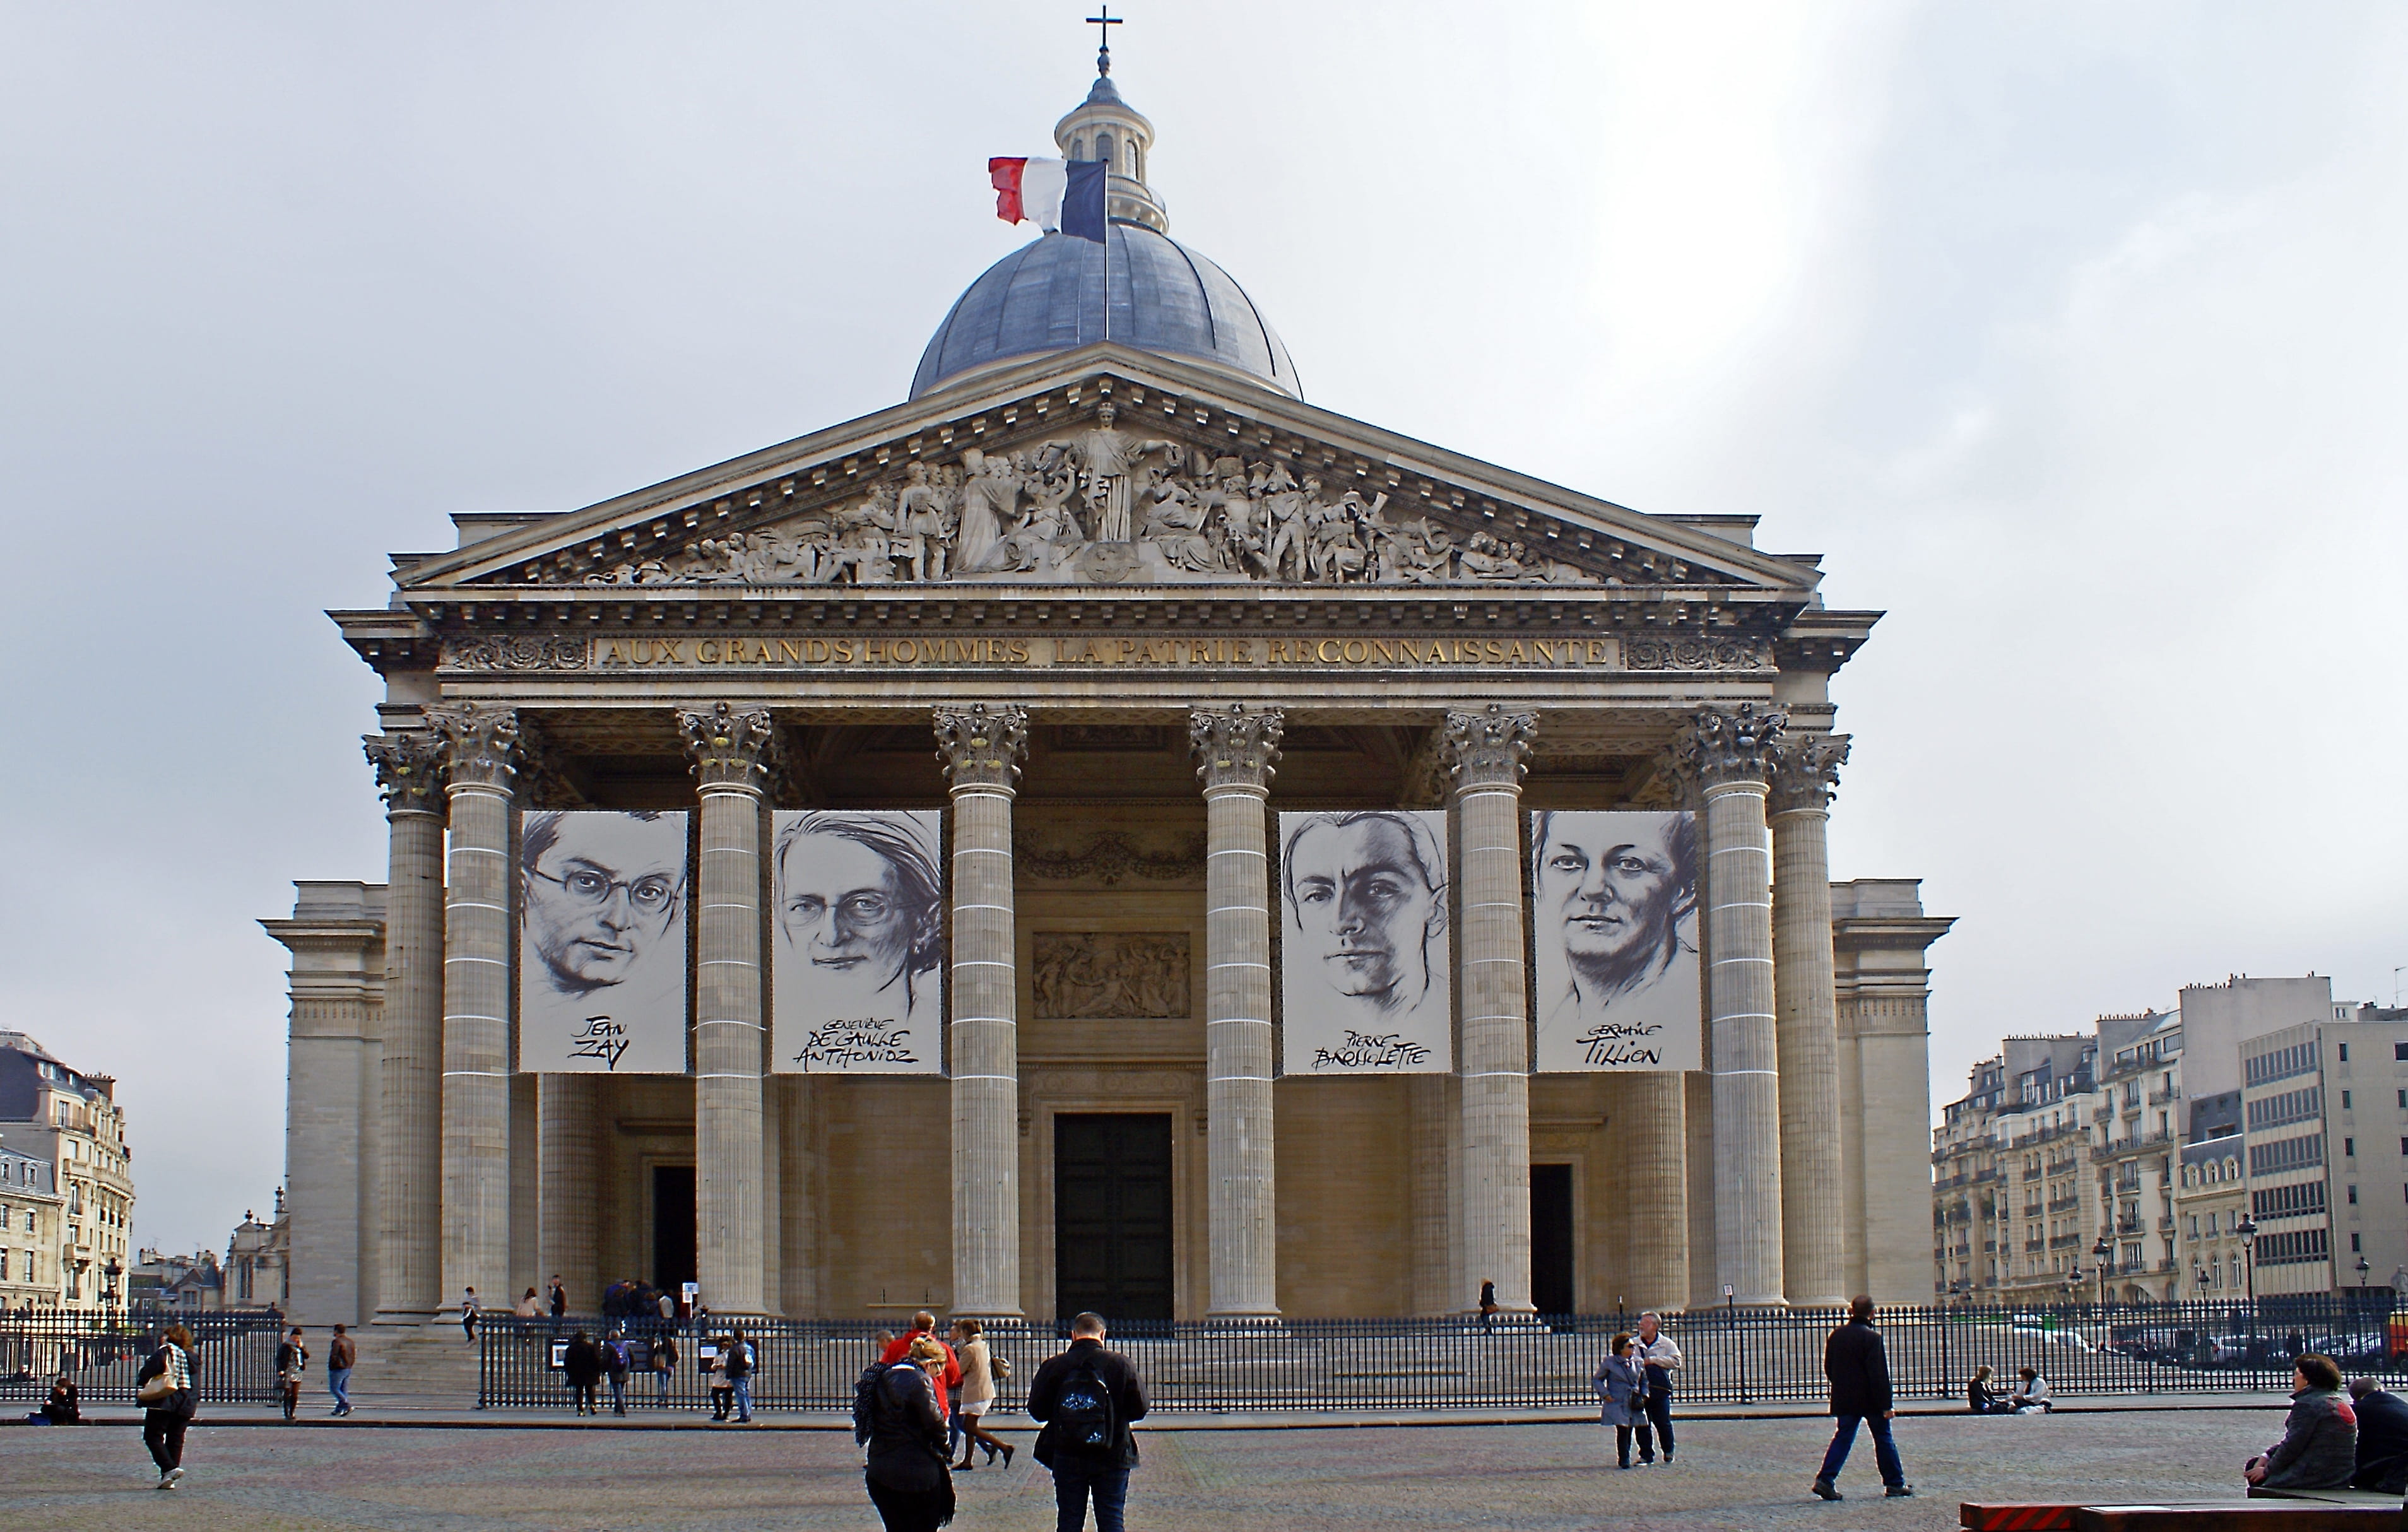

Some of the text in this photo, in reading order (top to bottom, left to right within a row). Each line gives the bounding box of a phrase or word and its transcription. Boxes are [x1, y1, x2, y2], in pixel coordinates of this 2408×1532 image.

[602, 639, 1607, 664] AUX GRANDS HOMMES LA PATRIE RECONNAISSANTE
[570, 1015, 627, 1037] JEAN
[808, 1030, 911, 1049] DE GAULLE
[567, 1039, 630, 1071] ZAY
[1311, 1042, 1431, 1071] BROSSOLETTE
